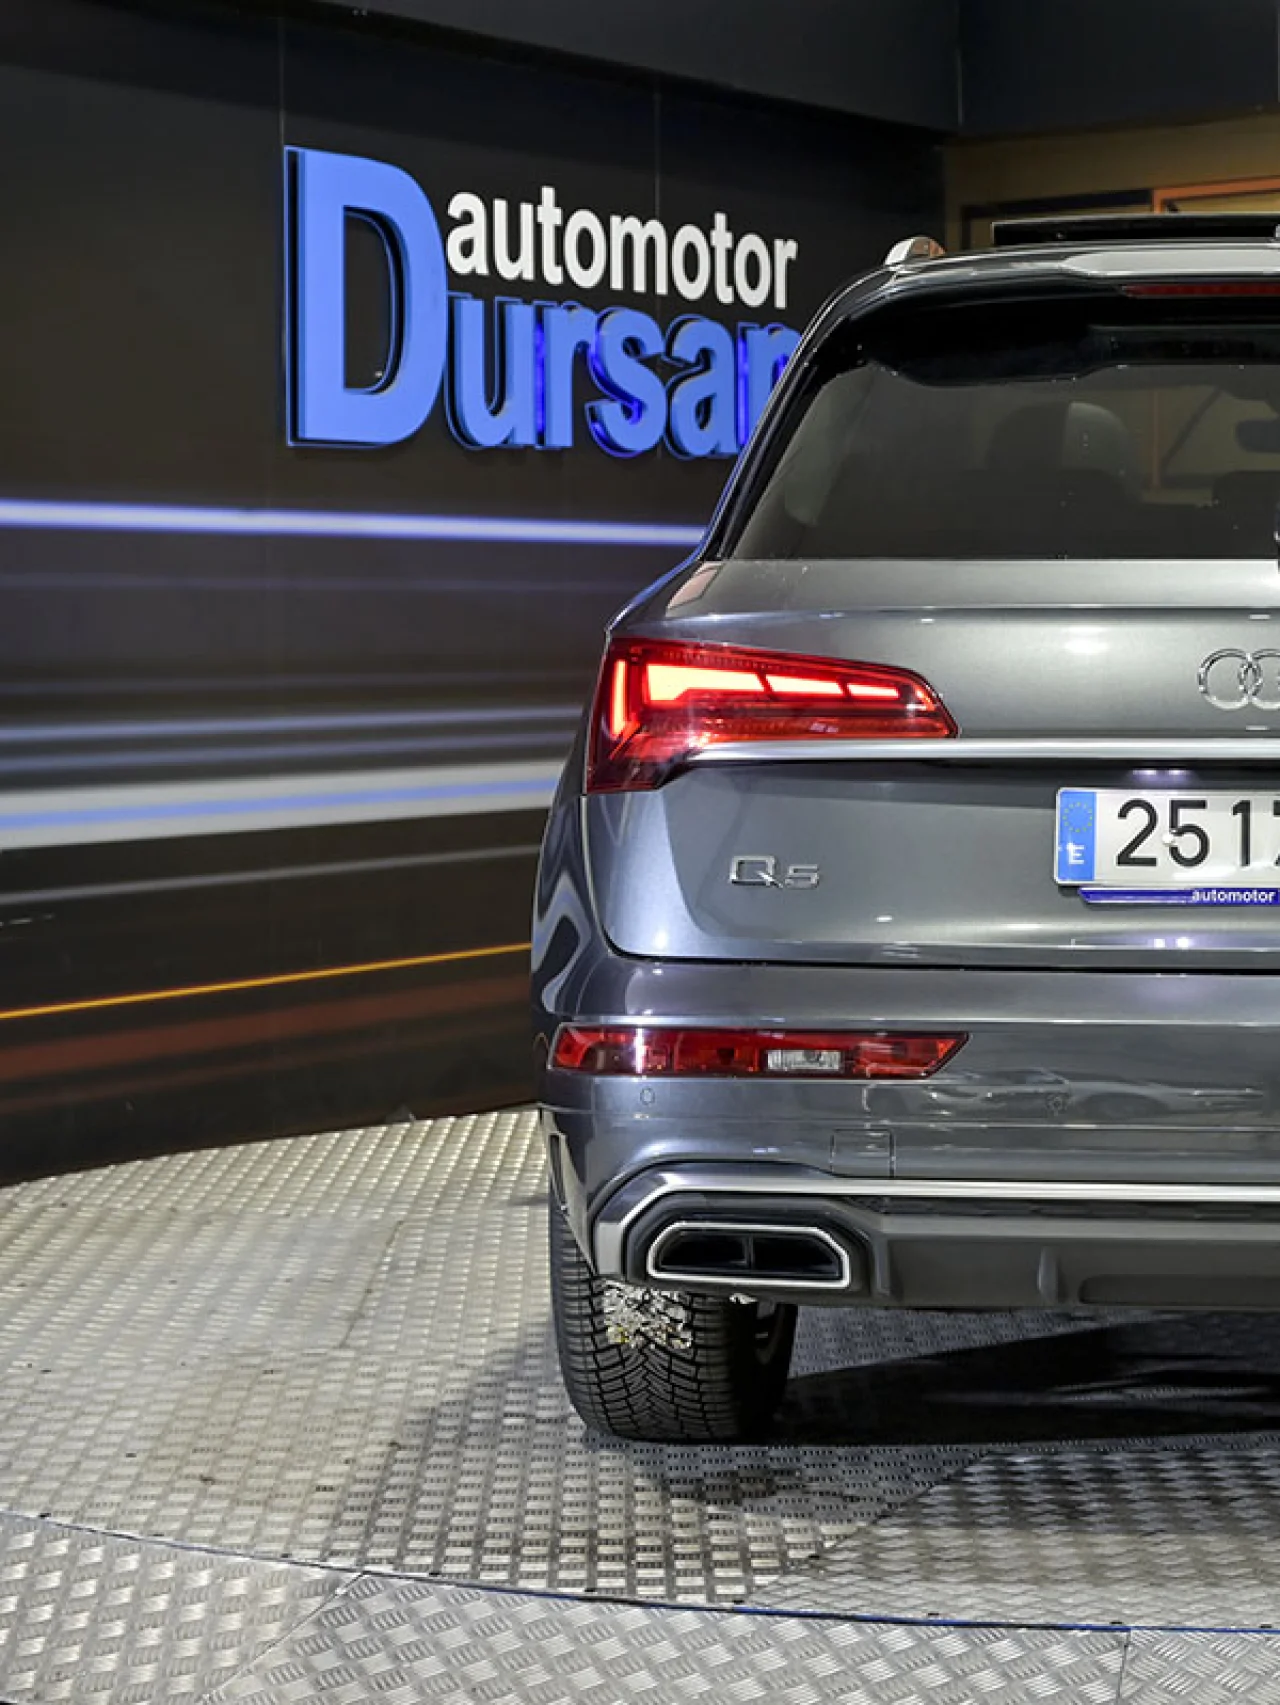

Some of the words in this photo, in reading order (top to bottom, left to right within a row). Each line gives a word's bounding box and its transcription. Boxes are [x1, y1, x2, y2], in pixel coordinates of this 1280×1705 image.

[446, 186, 798, 309] automotor
[1067, 843, 1085, 865] E
[729, 855, 820, 889] Q5
[1191, 889, 1275, 904] automotor
